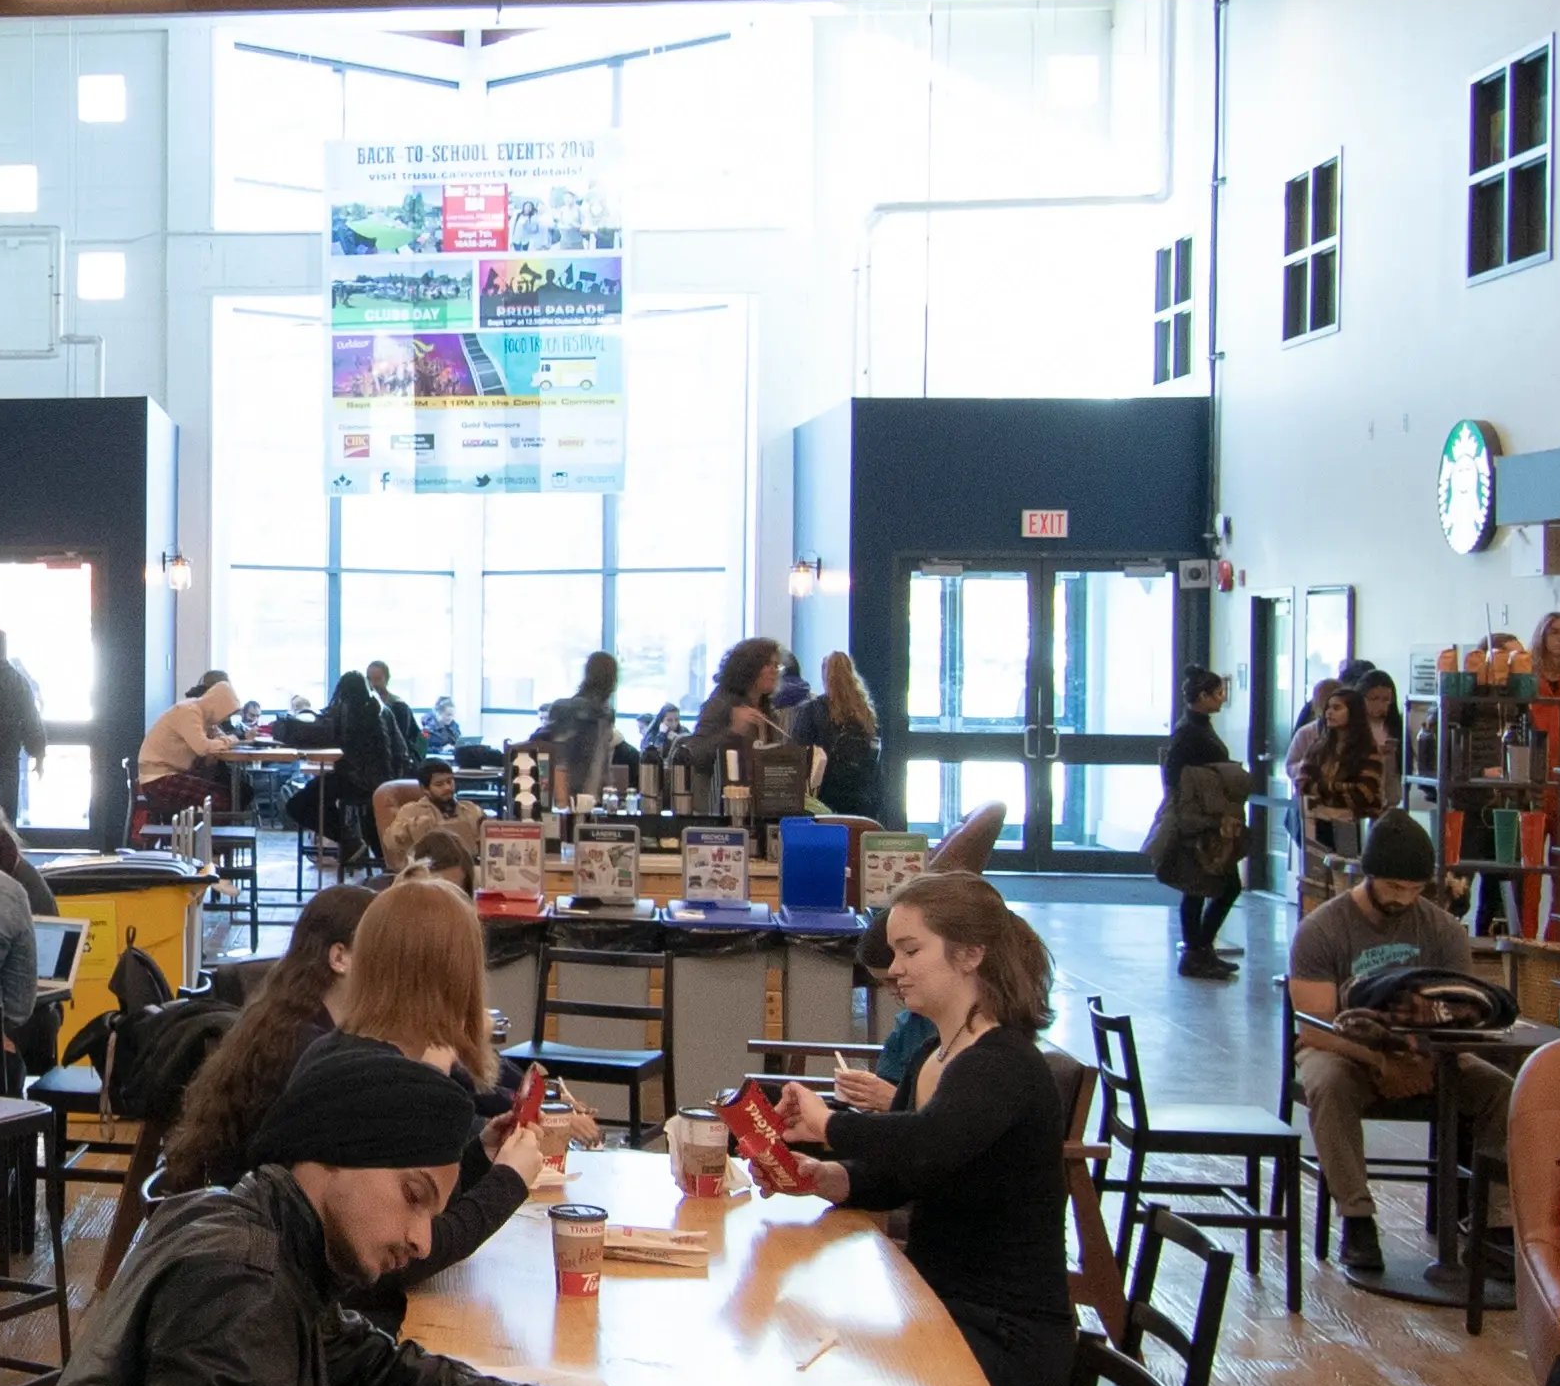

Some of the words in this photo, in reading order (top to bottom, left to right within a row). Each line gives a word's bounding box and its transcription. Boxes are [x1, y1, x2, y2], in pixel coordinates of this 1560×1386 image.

[497, 142, 555, 161] EVENTS
[509, 167, 528, 178] for
[412, 307, 440, 321] DAY
[496, 304, 541, 317] PRIDE
[545, 303, 605, 316] PARADE
[504, 334, 529, 355] FOOD
[491, 399, 510, 407] the
[1030, 513, 1064, 534] EXIT
[569, 1225, 589, 1234] TIM
